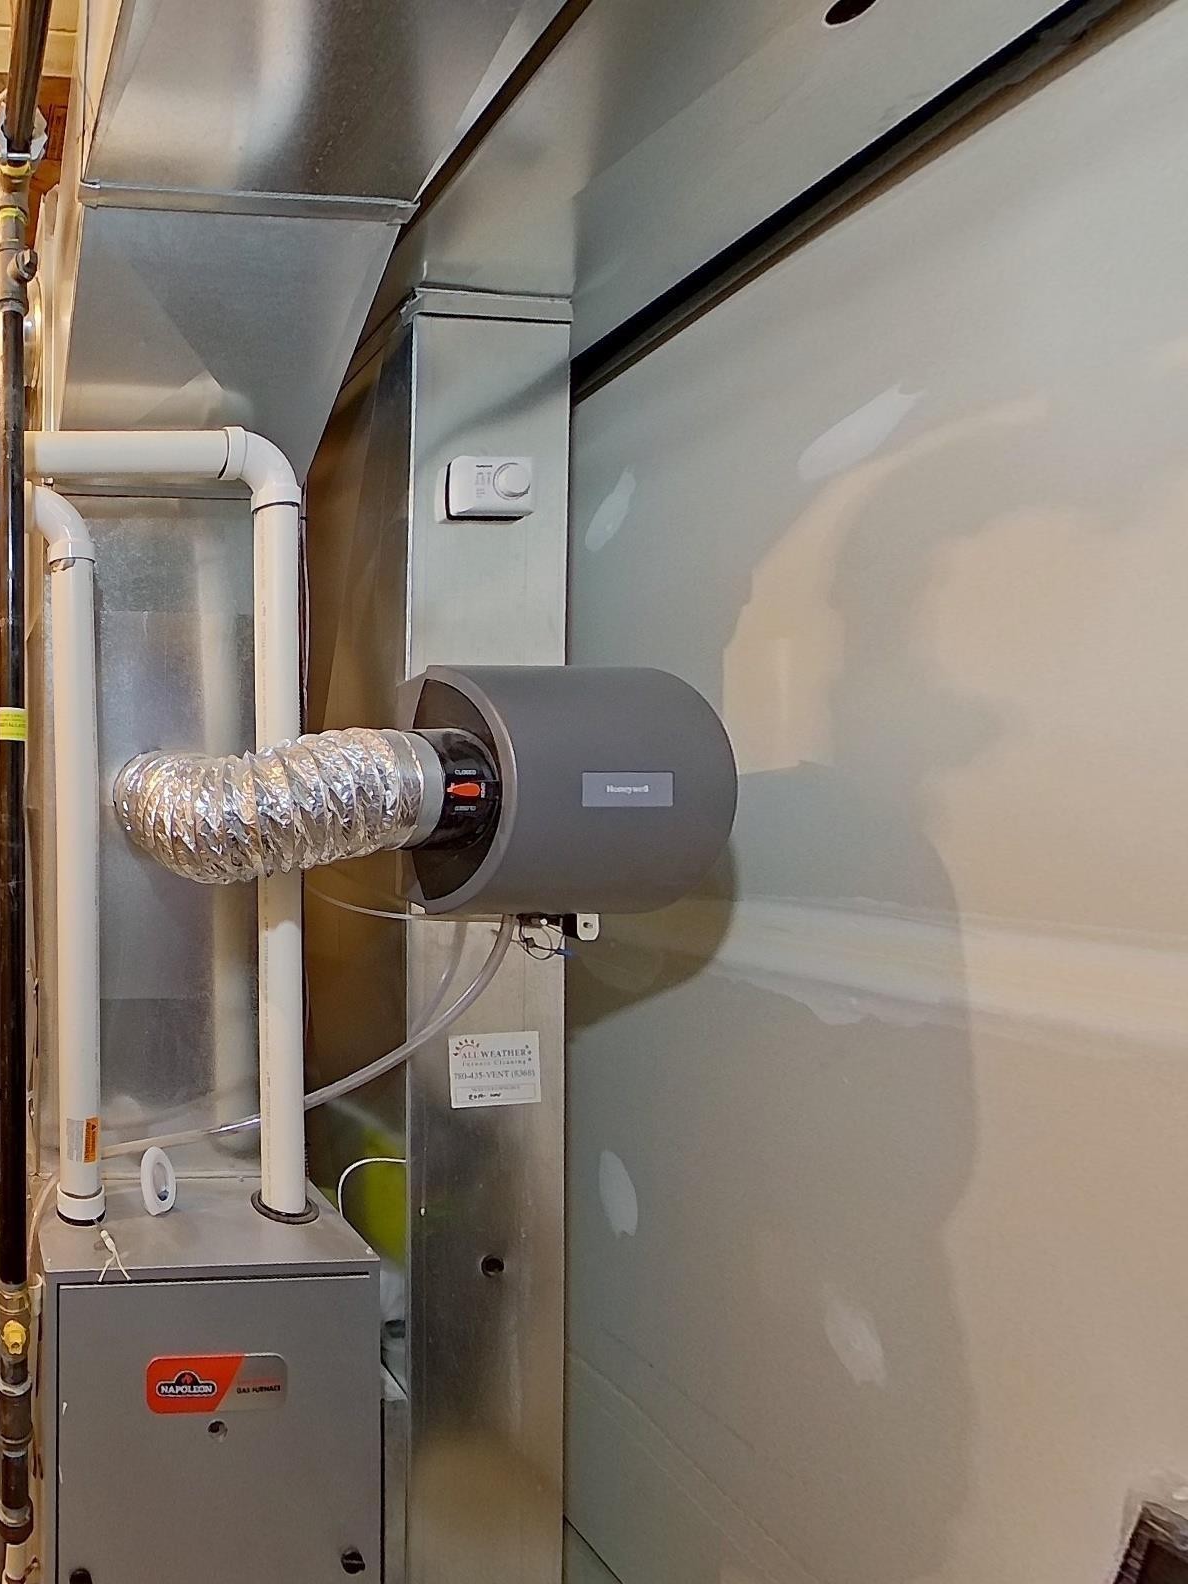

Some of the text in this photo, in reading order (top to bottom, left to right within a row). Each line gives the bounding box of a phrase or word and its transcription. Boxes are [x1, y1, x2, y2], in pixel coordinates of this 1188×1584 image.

[606, 784, 649, 795] Honeywell
[462, 1048, 527, 1060] ALL WEATHER
[160, 1384, 213, 1394] NAPOLEON
[252, 1384, 281, 1393] FURNACE
